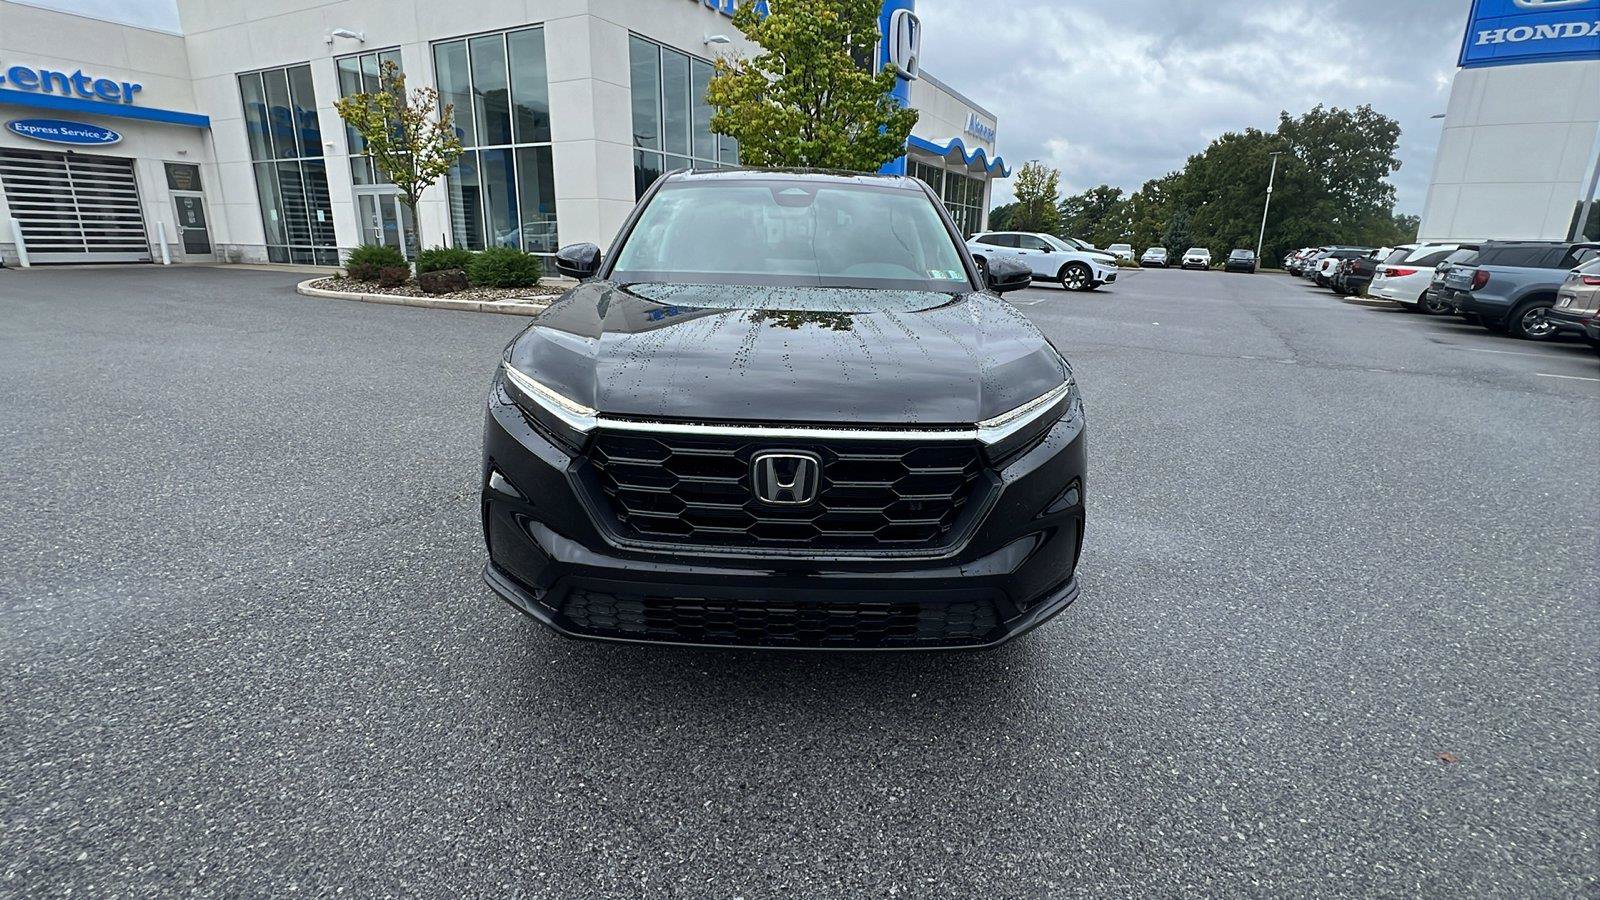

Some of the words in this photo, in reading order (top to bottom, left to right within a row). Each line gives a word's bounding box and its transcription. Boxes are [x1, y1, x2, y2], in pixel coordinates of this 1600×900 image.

[0, 65, 142, 104] enter
[14, 122, 59, 135] Express
[60, 126, 101, 139] Service
